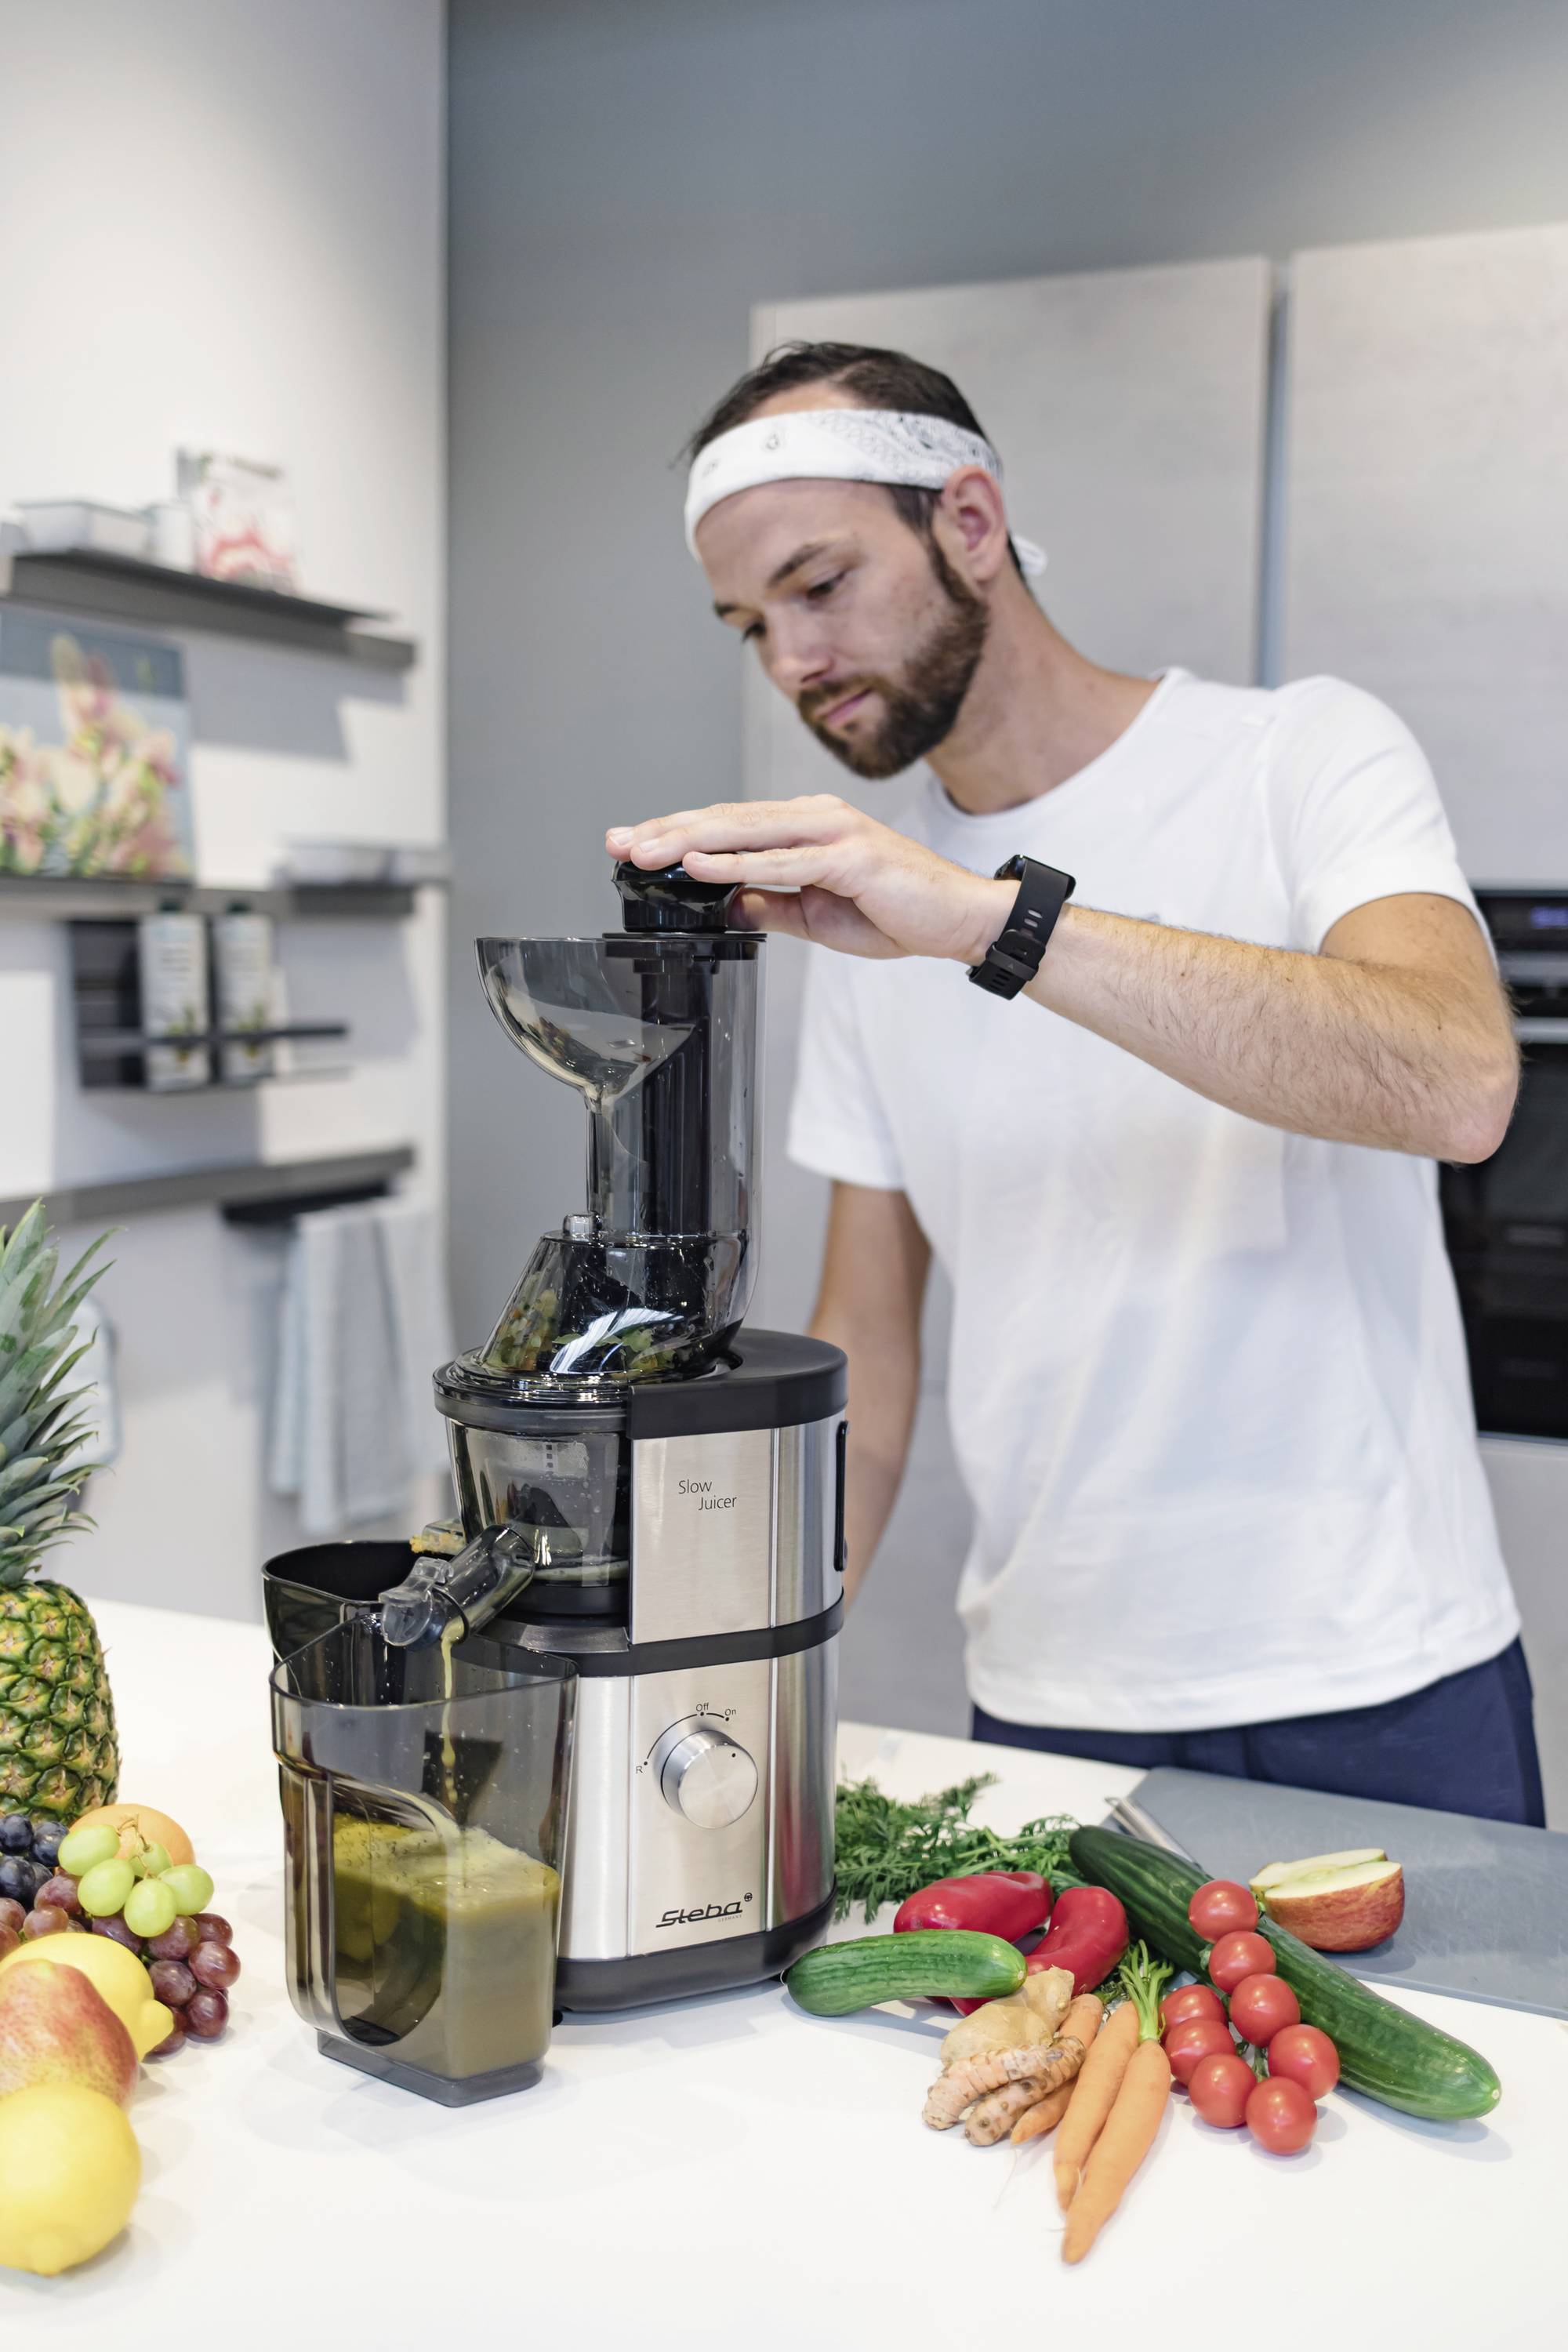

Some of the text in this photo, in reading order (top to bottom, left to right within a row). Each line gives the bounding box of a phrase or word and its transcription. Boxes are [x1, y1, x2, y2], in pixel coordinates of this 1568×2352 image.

[678, 1479, 713, 1494] Slow
[698, 1494, 738, 1511] Juicer
[695, 1702, 710, 1712] Off
[636, 1766, 644, 1774] R
[655, 1901, 743, 1928] Steba
